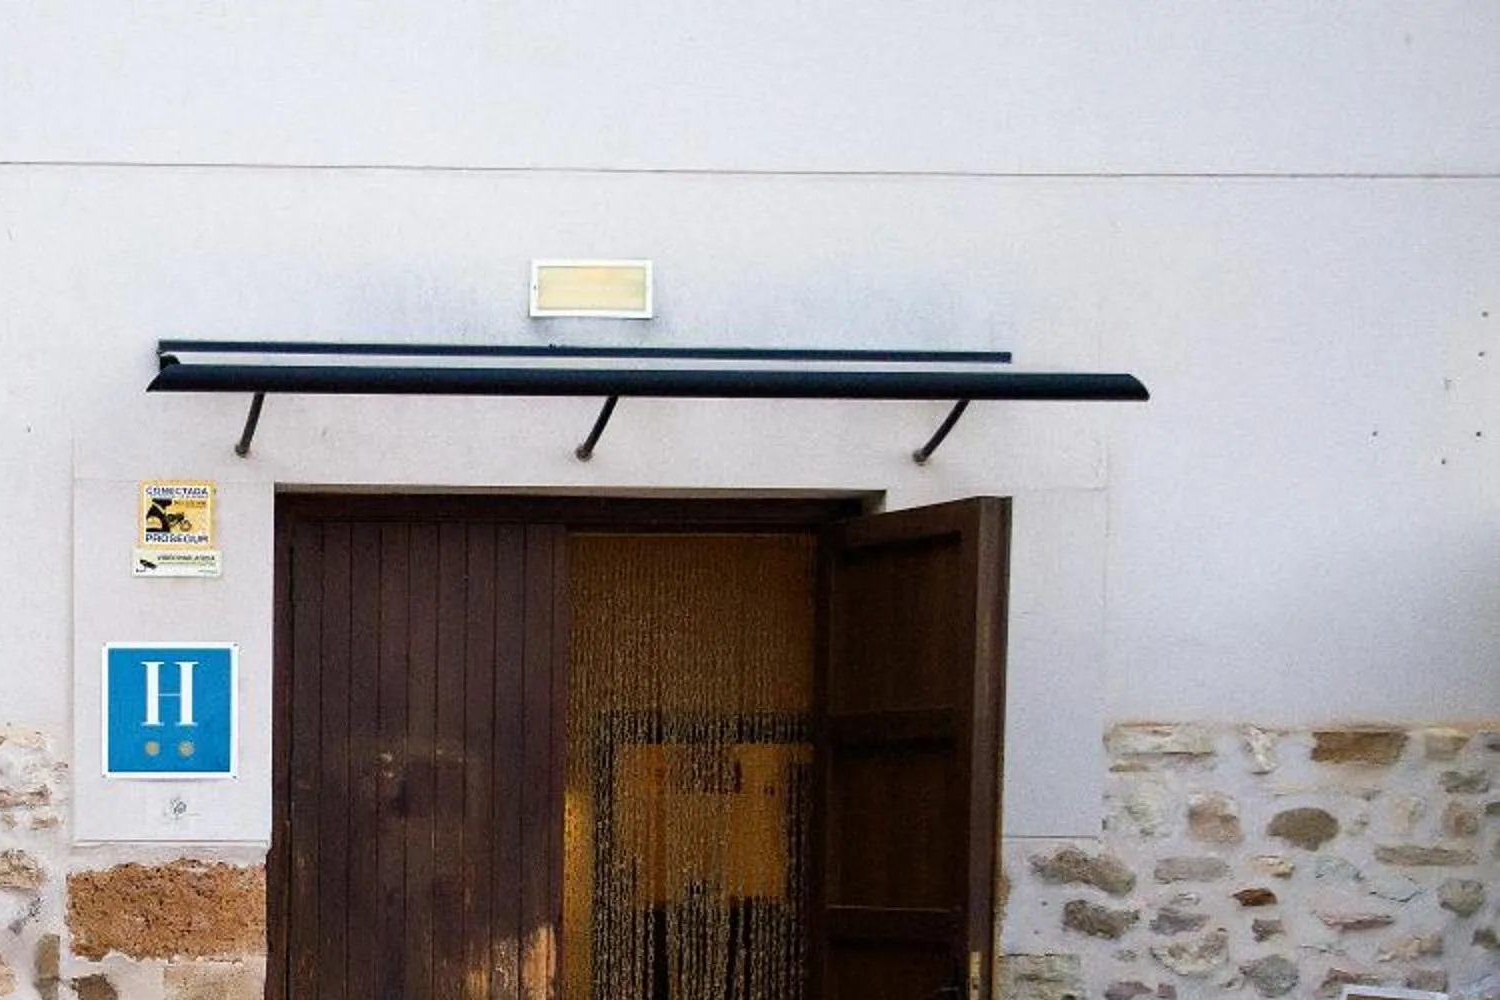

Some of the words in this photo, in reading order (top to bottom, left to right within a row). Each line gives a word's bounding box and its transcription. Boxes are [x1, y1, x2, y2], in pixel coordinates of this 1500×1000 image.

[145, 487, 209, 496] CONECTADA
[145, 534, 209, 544] PROSEGUR
[140, 661, 199, 727] H
